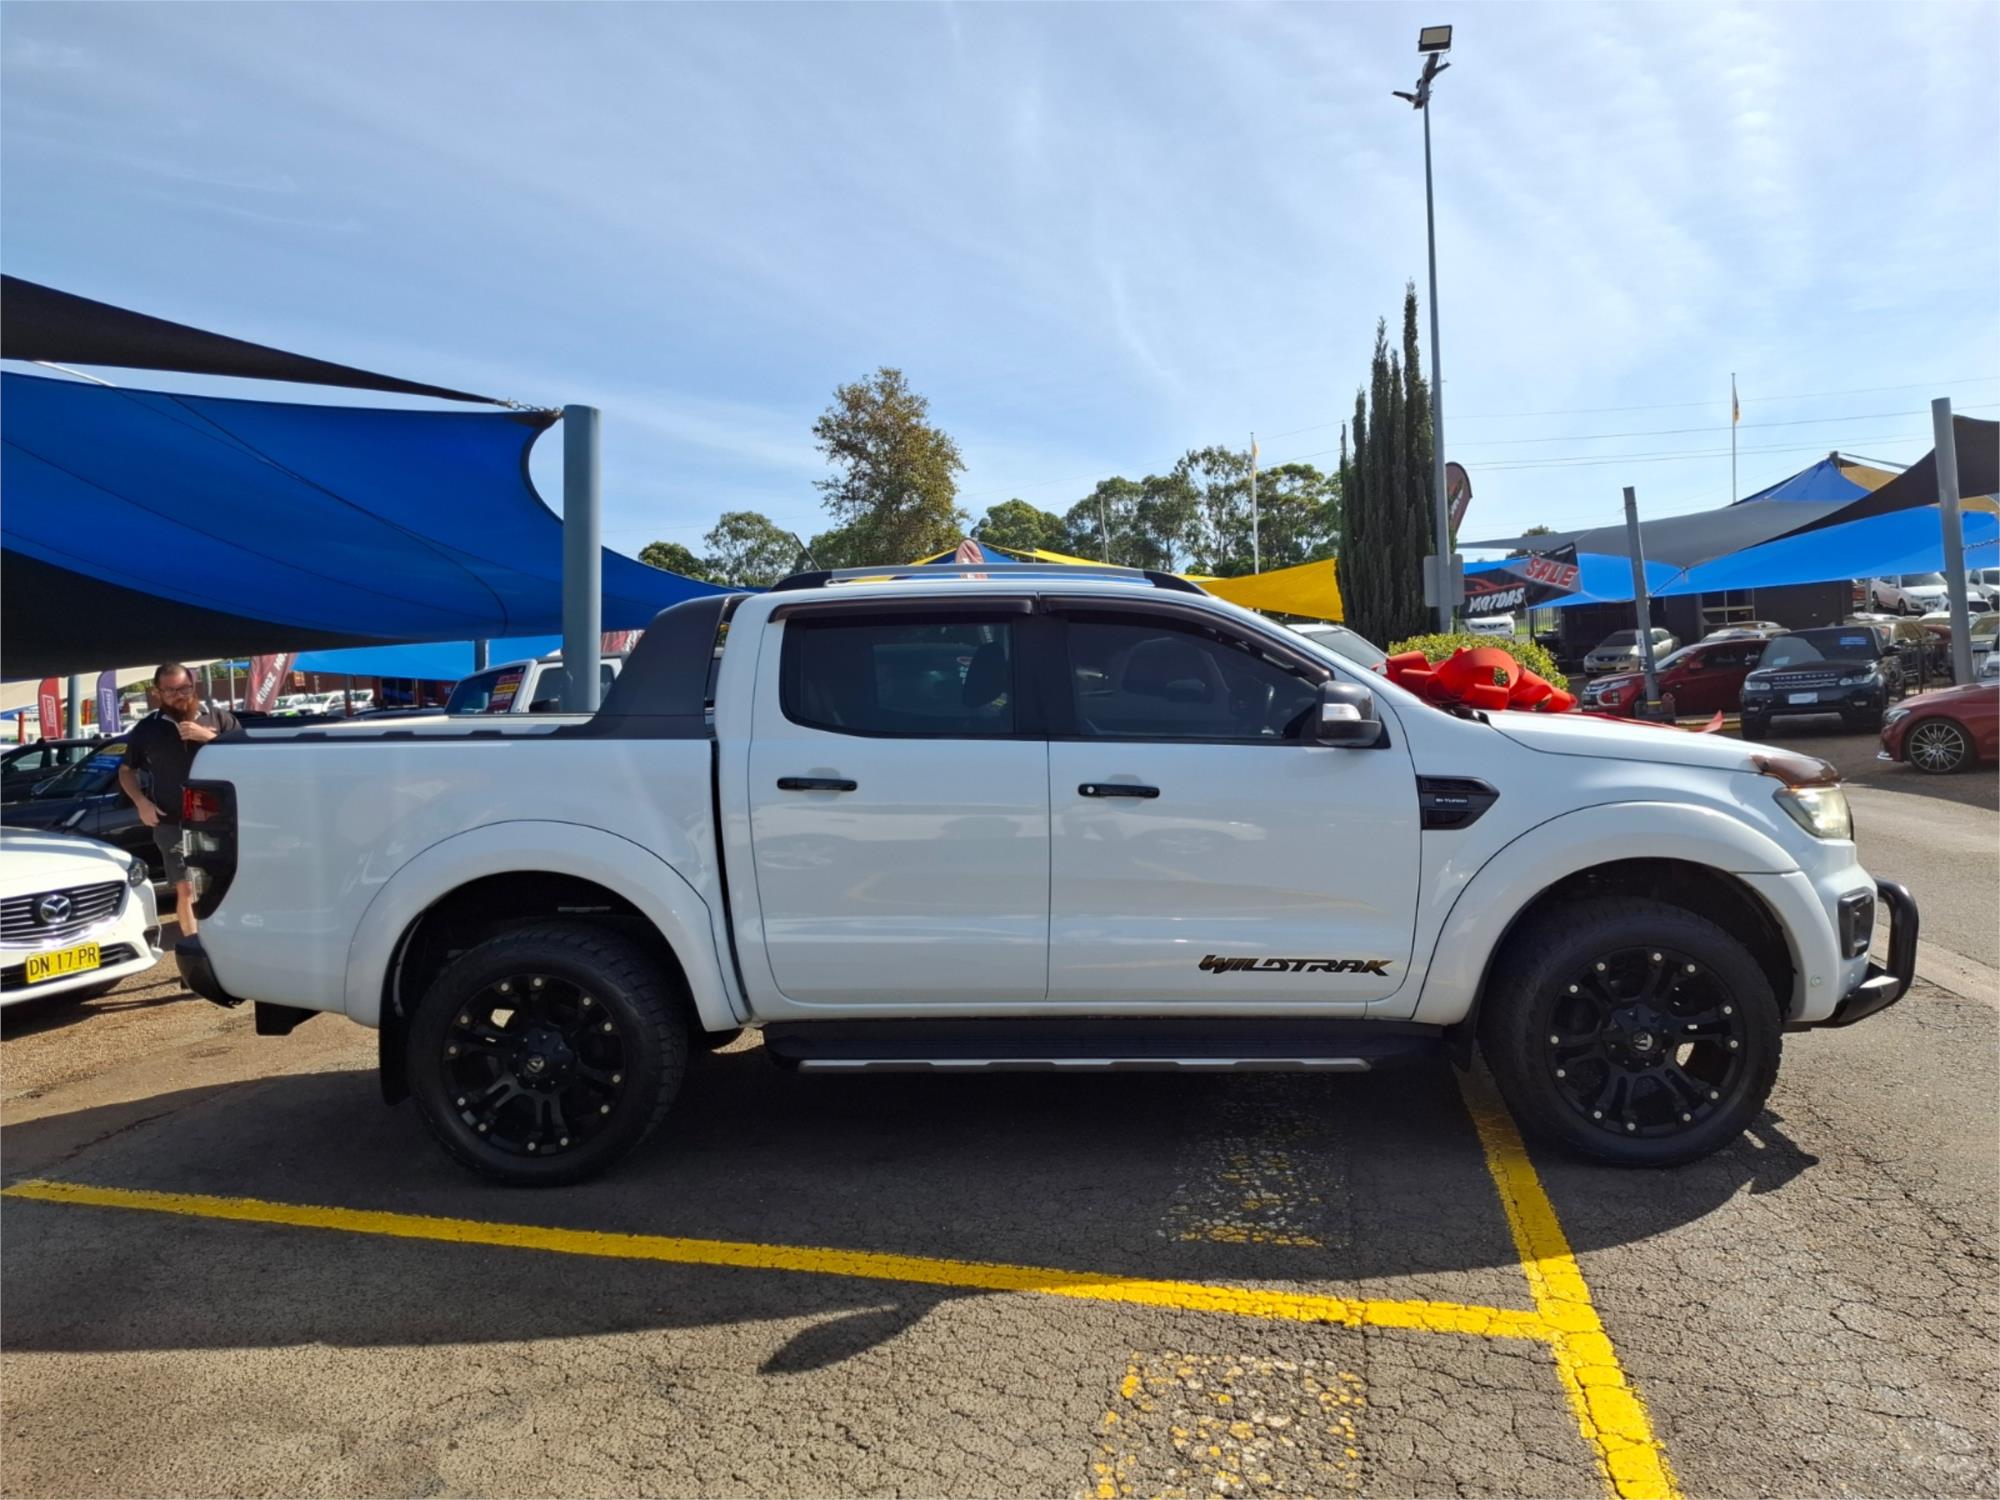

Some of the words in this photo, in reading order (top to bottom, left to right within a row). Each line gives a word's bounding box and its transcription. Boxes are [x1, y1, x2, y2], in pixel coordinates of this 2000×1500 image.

[1526, 559, 1578, 587] SALE
[1468, 587, 1525, 612] MOTORS
[256, 672, 276, 704] KINGZ
[29, 956, 50, 976] DN
[57, 951, 73, 969] 17
[78, 946, 97, 965] PR
[1199, 954, 1393, 976] WILDTRAK
